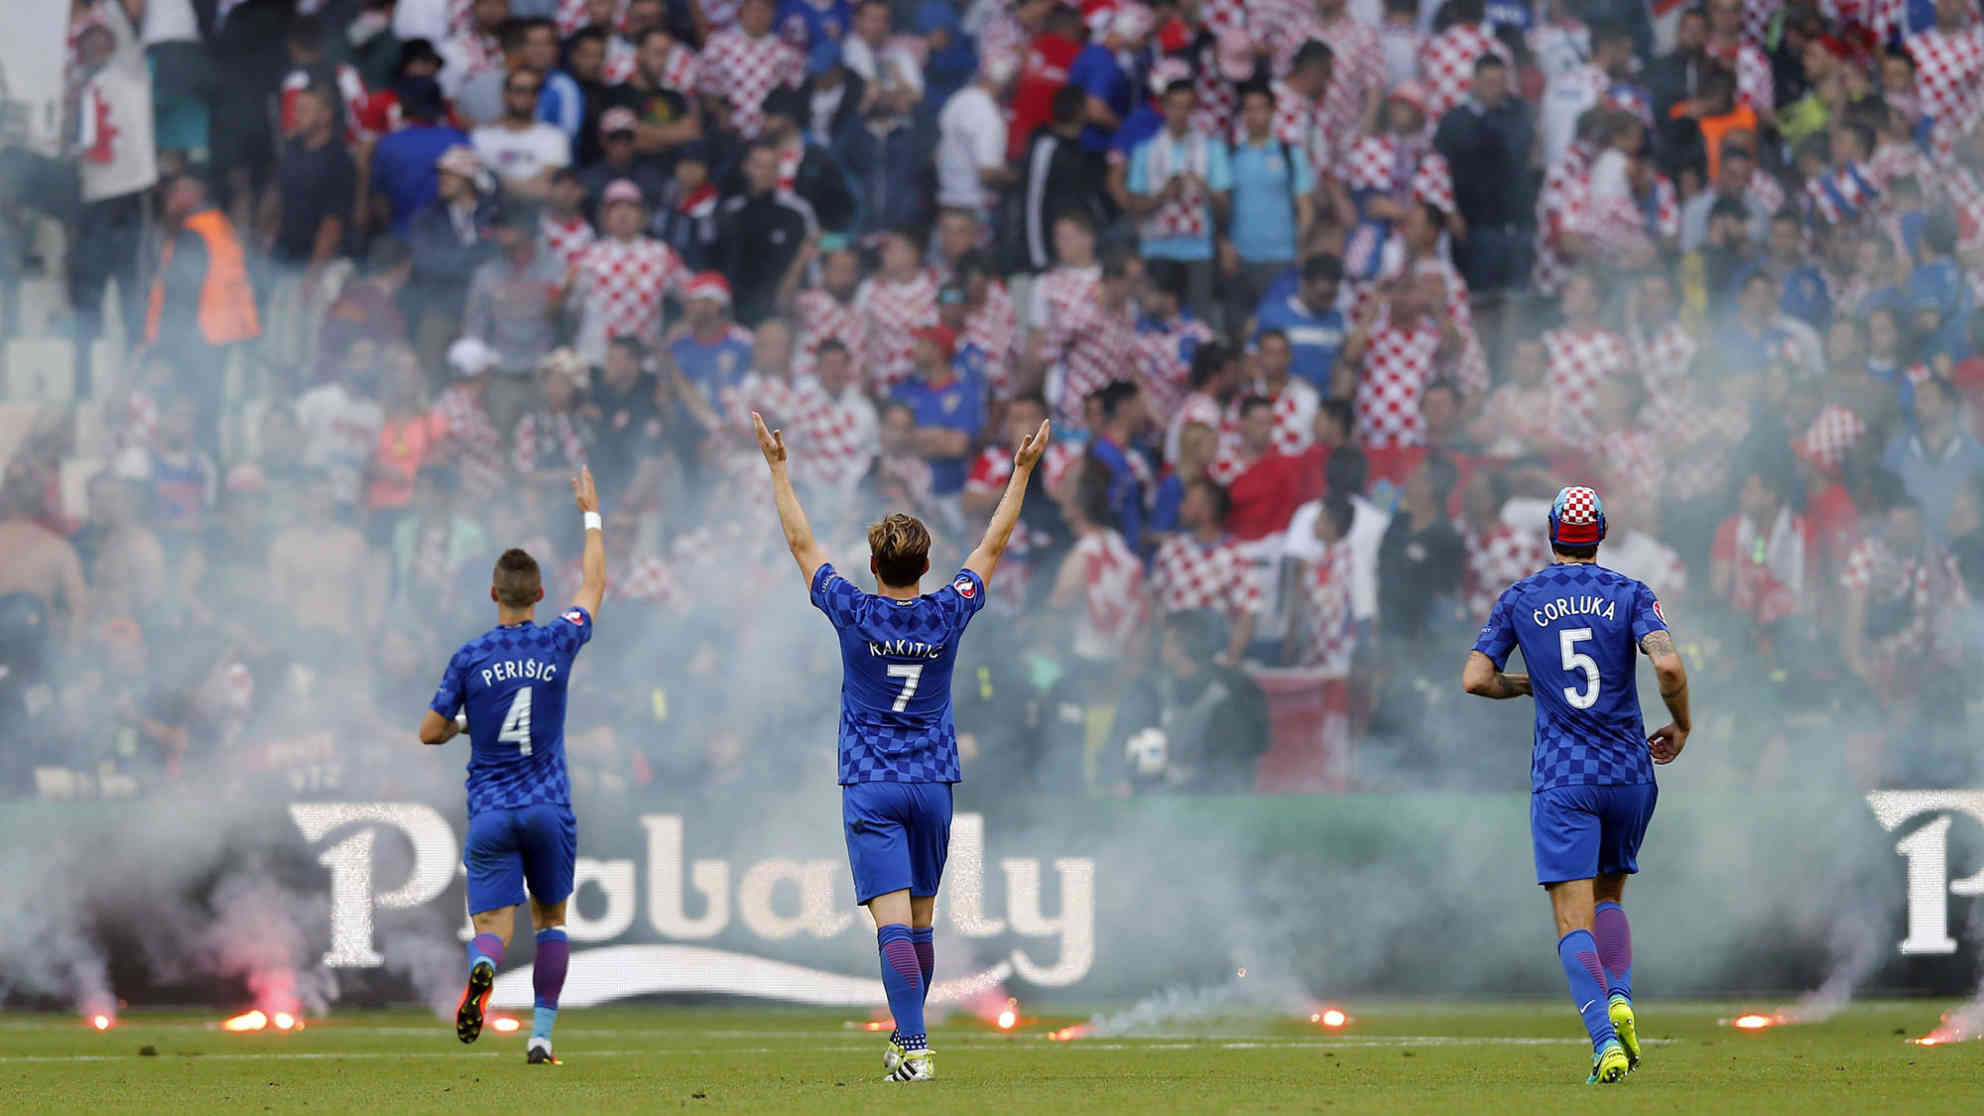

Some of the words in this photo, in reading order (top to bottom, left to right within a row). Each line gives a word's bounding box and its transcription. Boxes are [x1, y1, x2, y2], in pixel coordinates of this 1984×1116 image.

[887, 664, 924, 713] 7
[1560, 627, 1600, 710] 5
[497, 686, 533, 756] 4
[288, 803, 1095, 987] Pobaly
